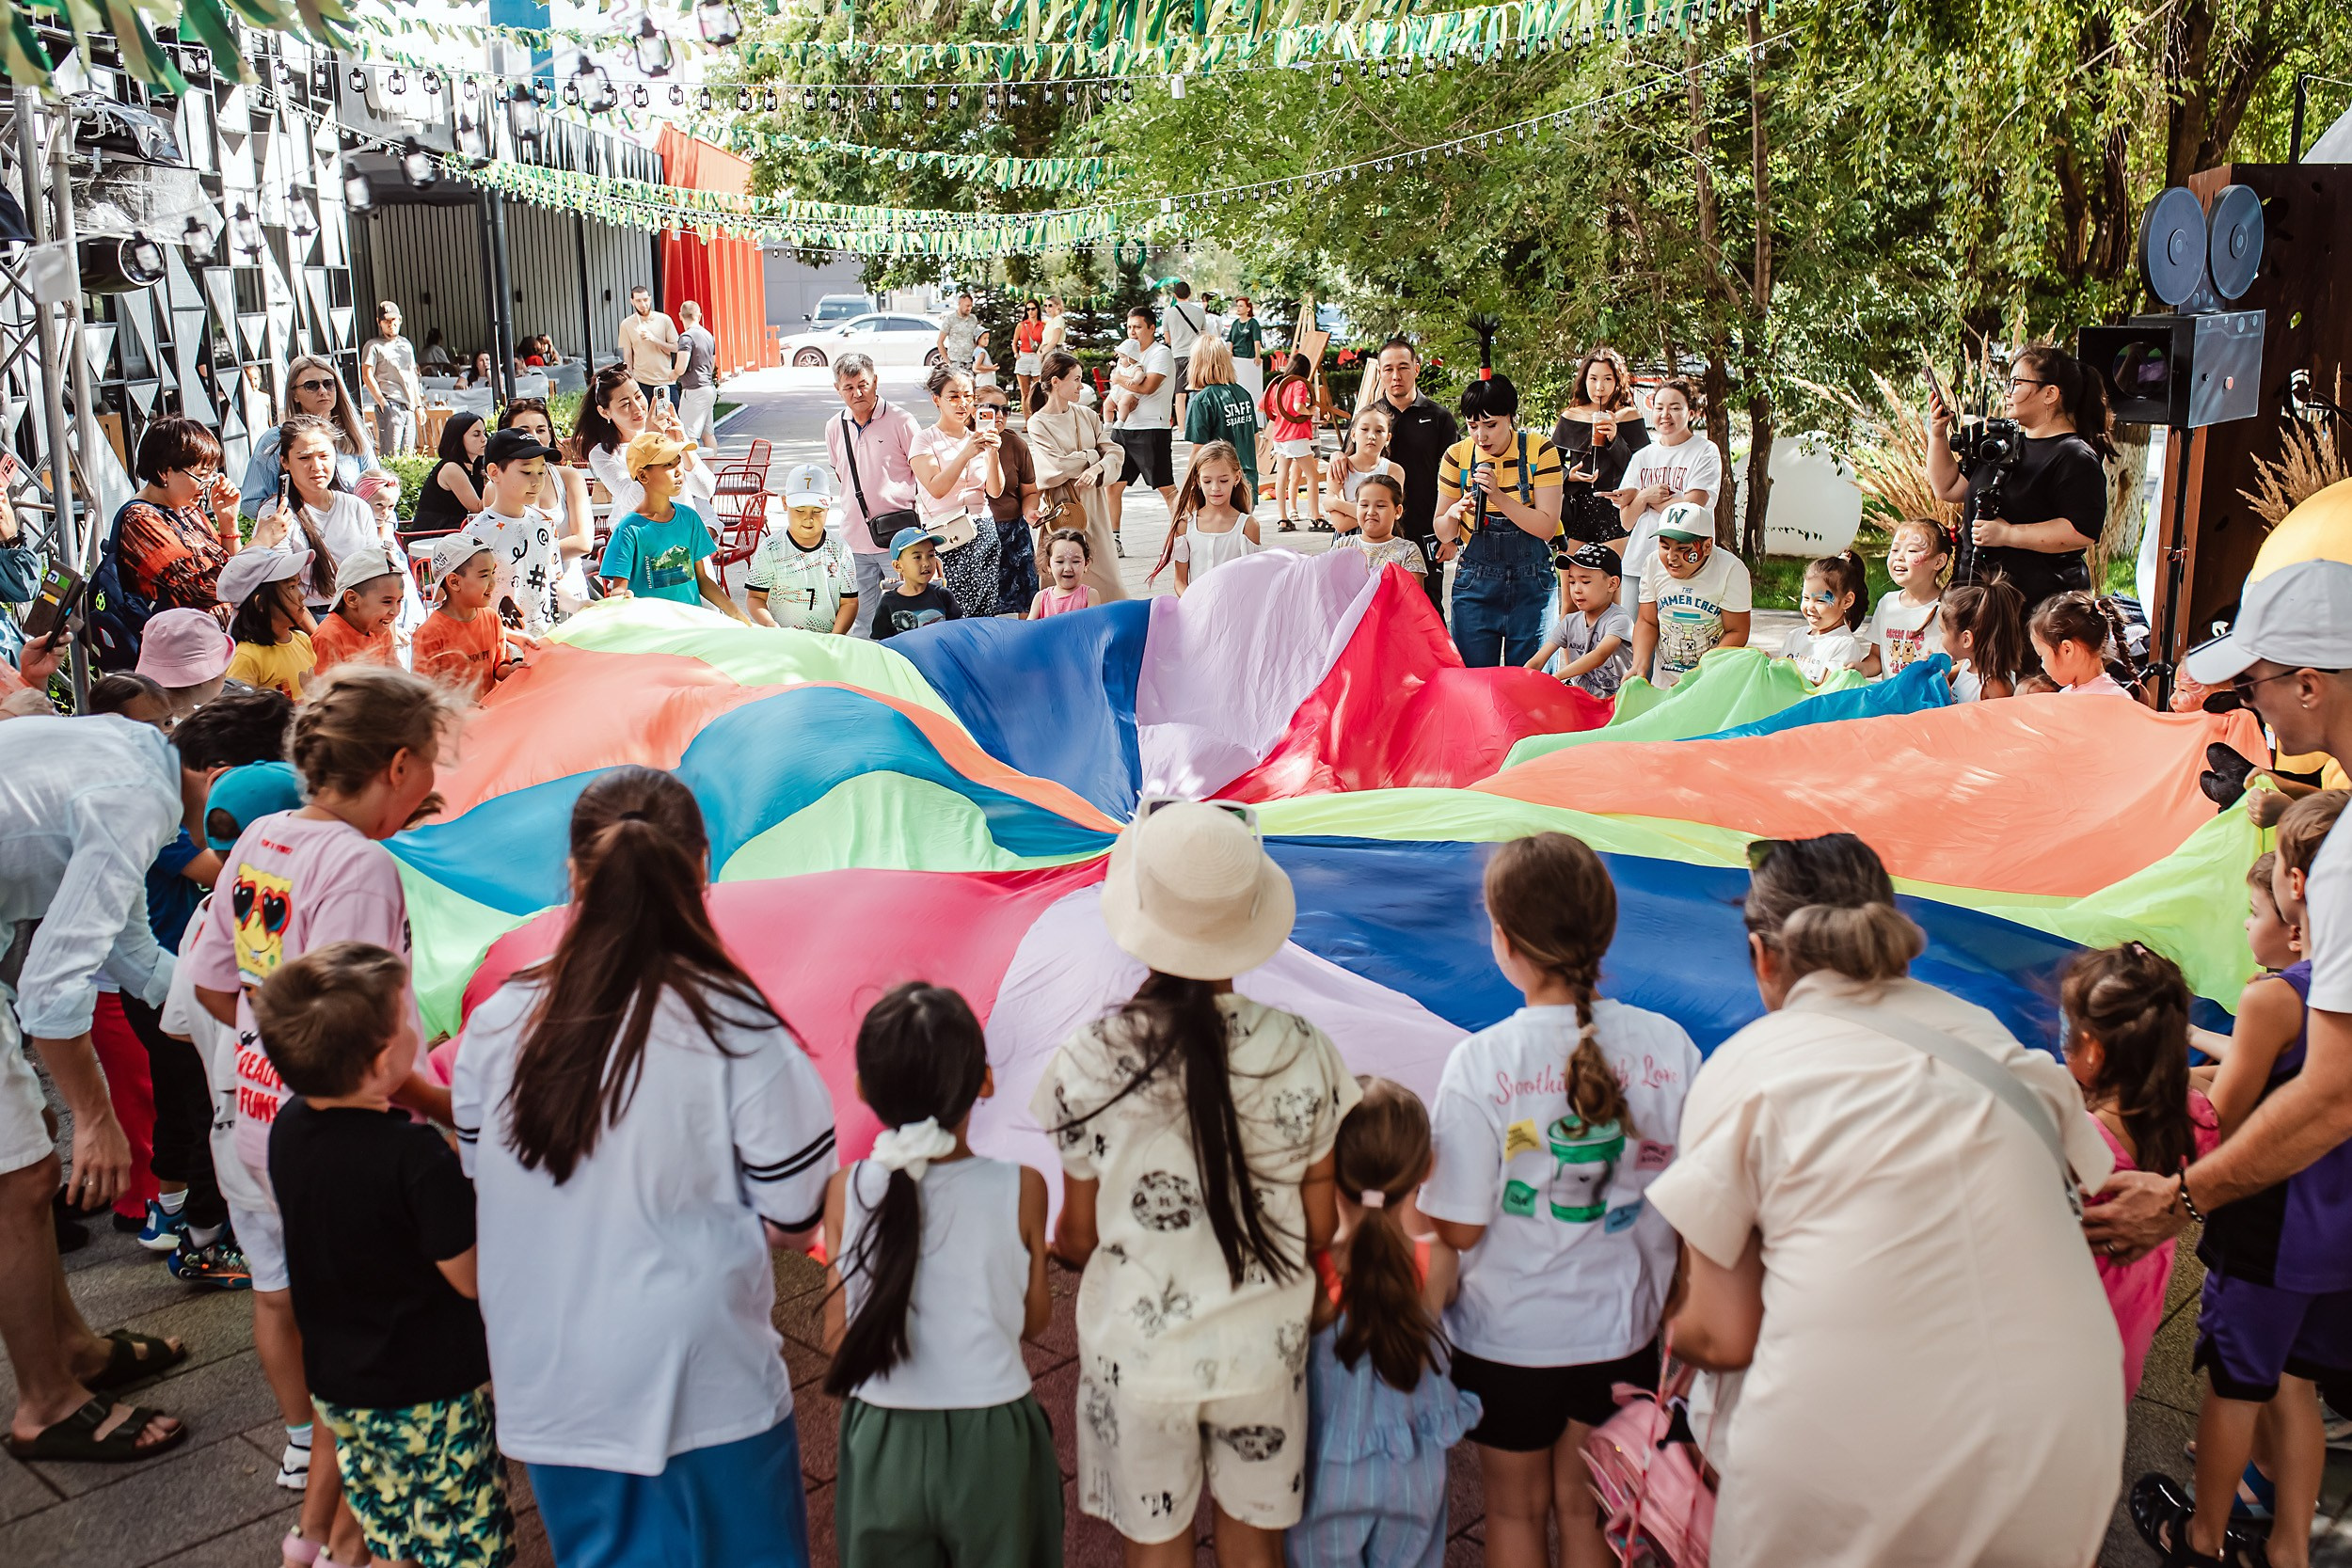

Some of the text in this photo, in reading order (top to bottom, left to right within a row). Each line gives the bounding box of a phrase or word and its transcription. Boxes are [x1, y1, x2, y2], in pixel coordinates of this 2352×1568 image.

[1224, 401, 1251, 418] STAFF
[803, 477, 812, 490] 7
[1667, 507, 1689, 524] W
[806, 588, 816, 610] 7
[1657, 594, 1692, 614] UMMER
